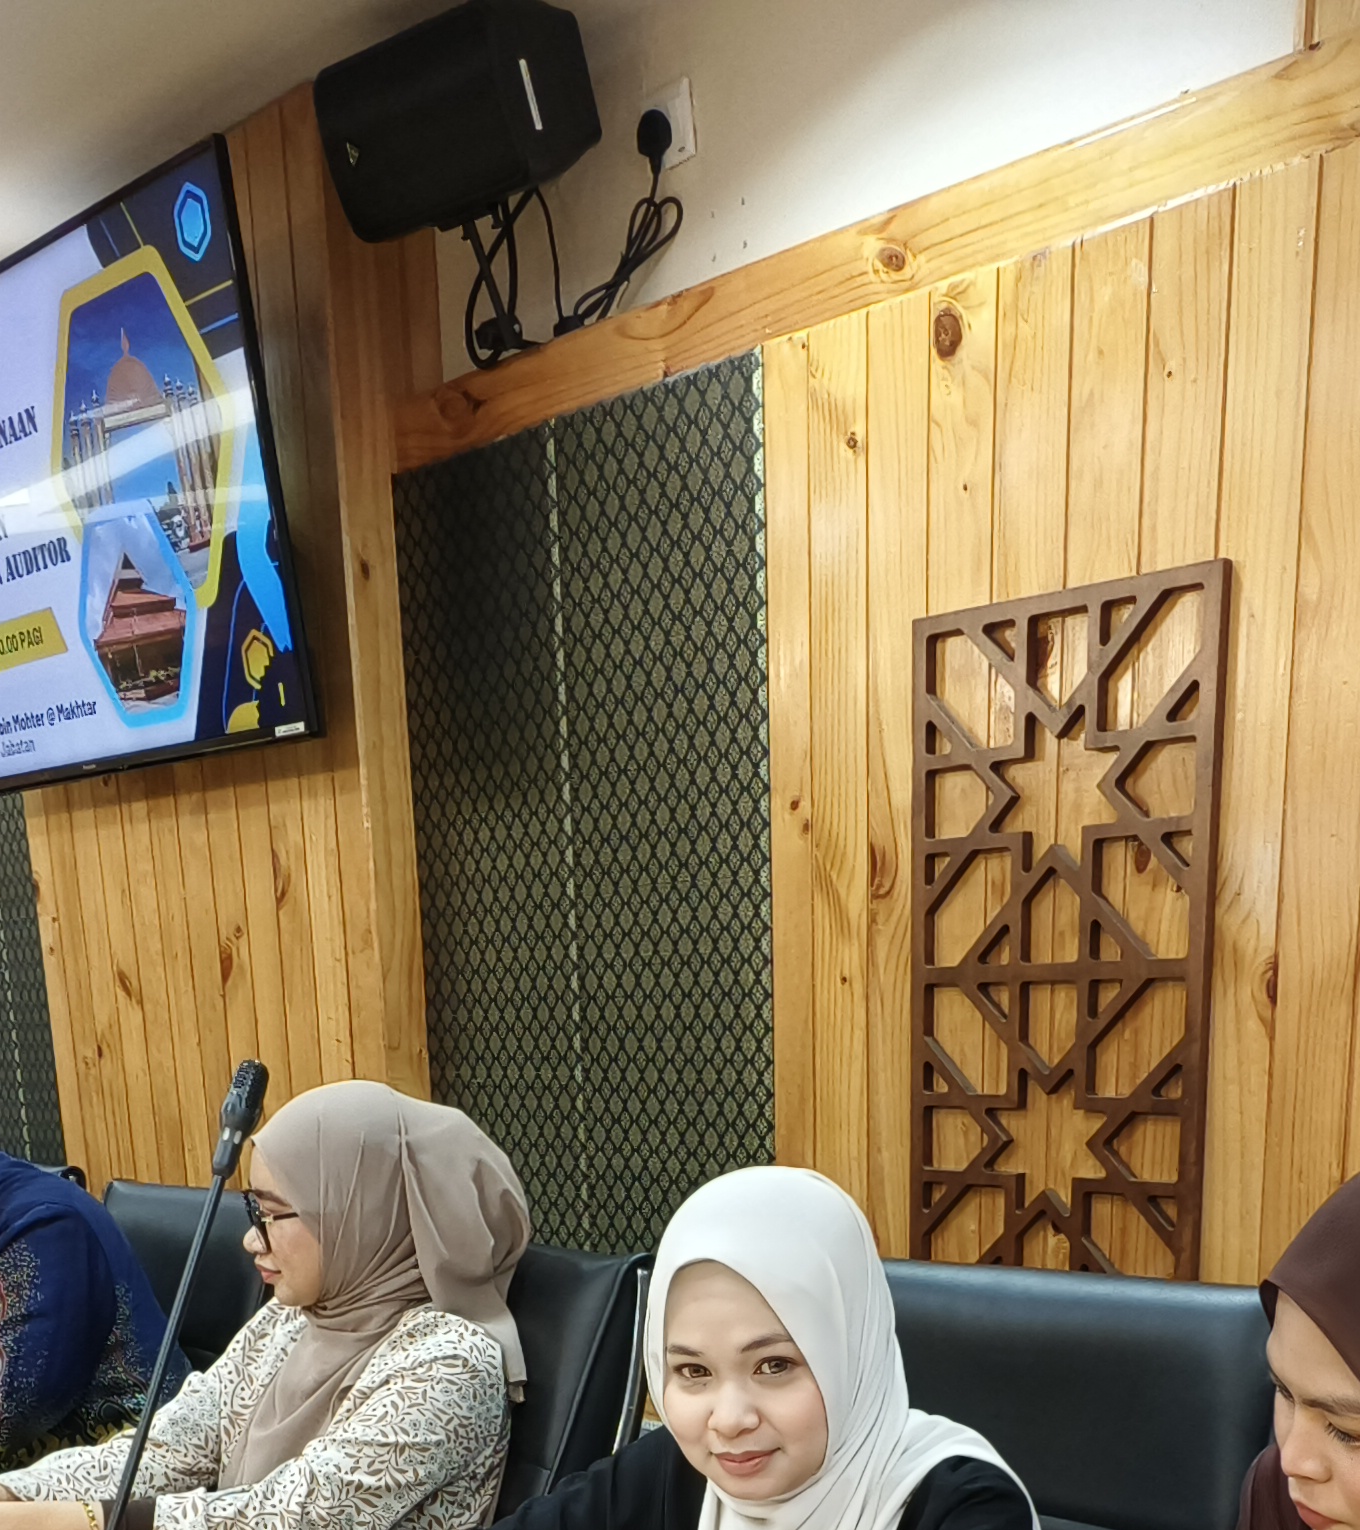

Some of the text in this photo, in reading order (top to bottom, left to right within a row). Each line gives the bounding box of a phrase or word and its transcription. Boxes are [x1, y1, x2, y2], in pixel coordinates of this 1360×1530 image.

[6, 537, 71, 582] AUDITOR
[18, 626, 43, 650] PAGI
[56, 700, 96, 723] Makhtar
